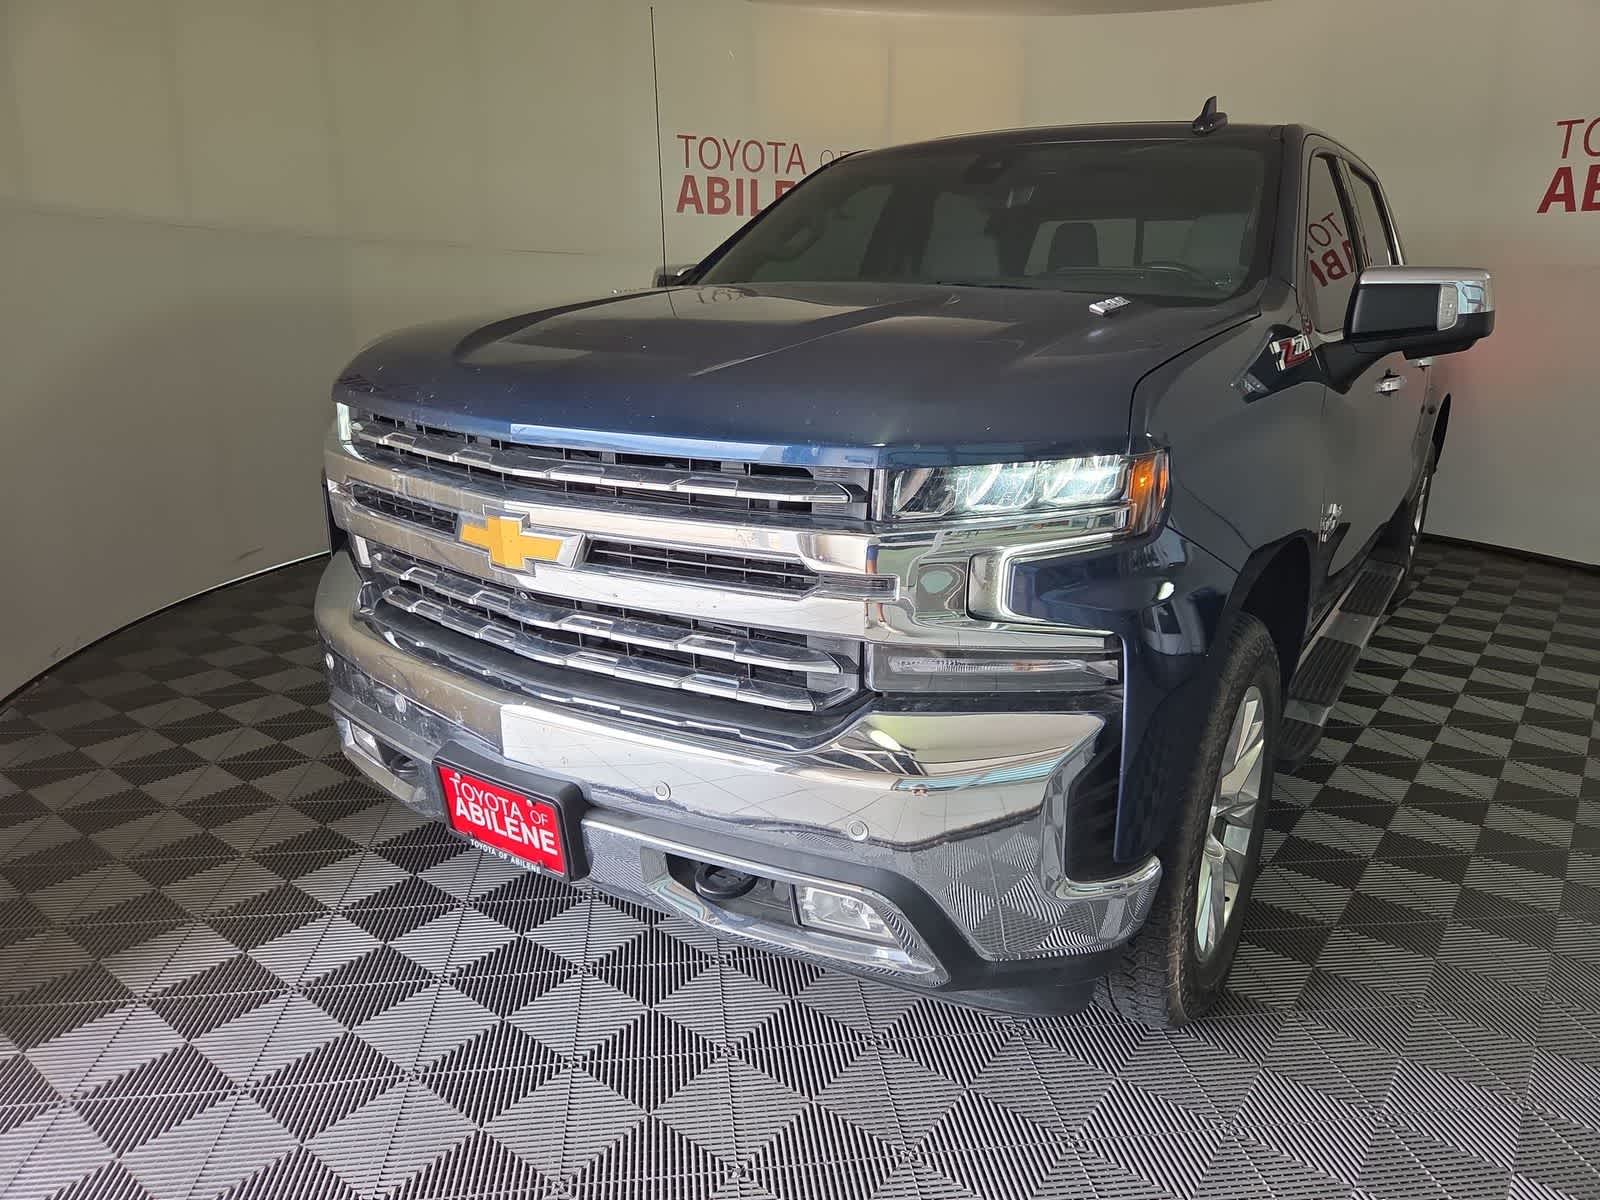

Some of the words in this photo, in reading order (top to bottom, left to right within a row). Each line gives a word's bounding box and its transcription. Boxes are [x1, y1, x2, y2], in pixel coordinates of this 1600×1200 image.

[676, 134, 806, 174] TOYOTA
[449, 776, 524, 821] TOYOTA
[530, 809, 549, 827] OF
[456, 797, 558, 856] ABILENE
[470, 838, 497, 856] TOYOTA
[498, 851, 508, 861] OF
[510, 855, 541, 874] ABILENE
